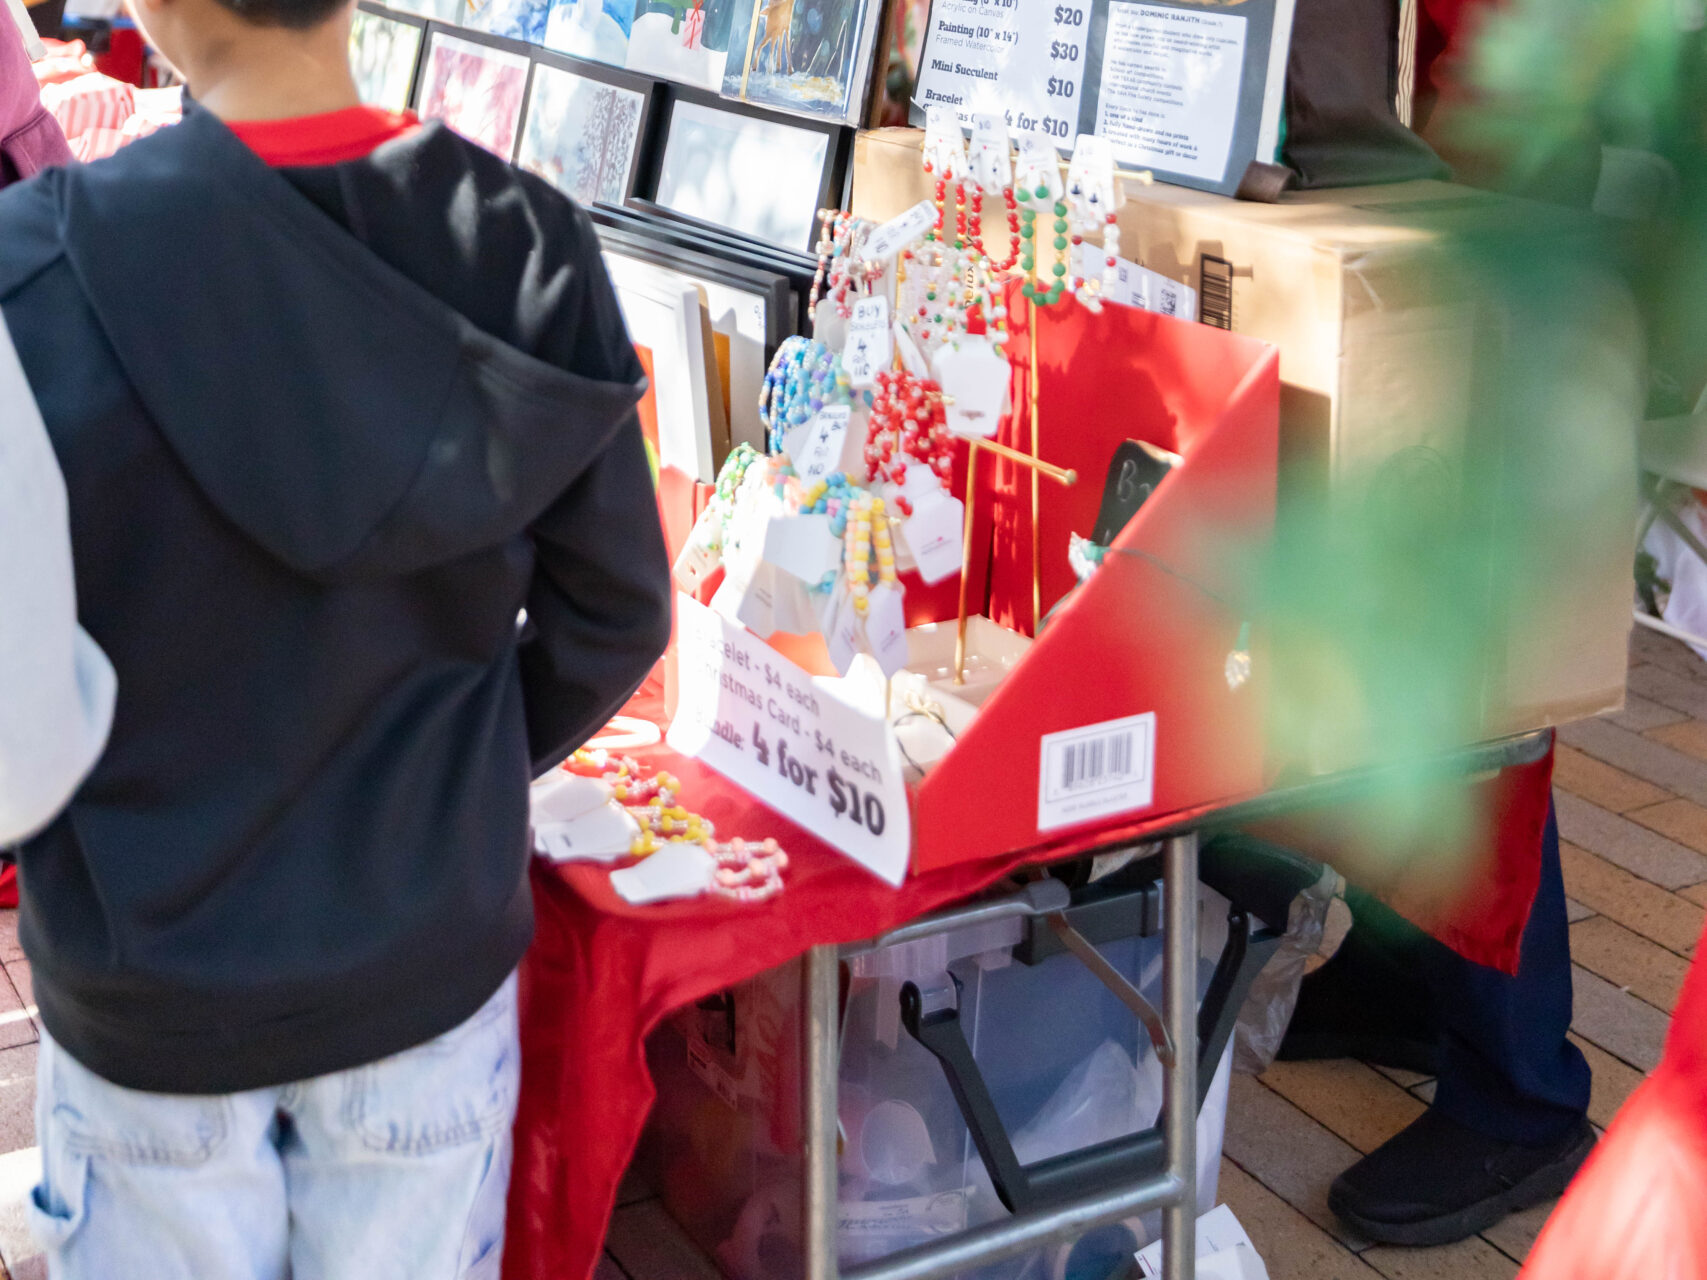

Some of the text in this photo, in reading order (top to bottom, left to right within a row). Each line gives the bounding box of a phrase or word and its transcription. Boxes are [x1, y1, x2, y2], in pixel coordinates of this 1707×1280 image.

[941, 1, 966, 13] Acrylic
[979, 7, 1004, 18] Canvas
[1054, 4, 1083, 27] $20
[1140, 9, 1169, 20] DOMINIC
[936, 34, 963, 47] Framed
[938, 20, 975, 38] Painting
[995, 32, 1001, 40] x
[1050, 39, 1079, 63] $30
[931, 59, 1075, 98] Mini Succulent $10
[924, 89, 963, 106] Bracelet
[1016, 112, 1038, 132] for
[1042, 115, 1069, 138] $10
[764, 663, 782, 691] $4
[786, 686, 820, 717] each
[767, 698, 800, 736] Card
[814, 728, 835, 757] $4
[841, 751, 883, 785] each
[752, 720, 770, 767] 4
[776, 739, 819, 796] for
[826, 766, 886, 837] $10
